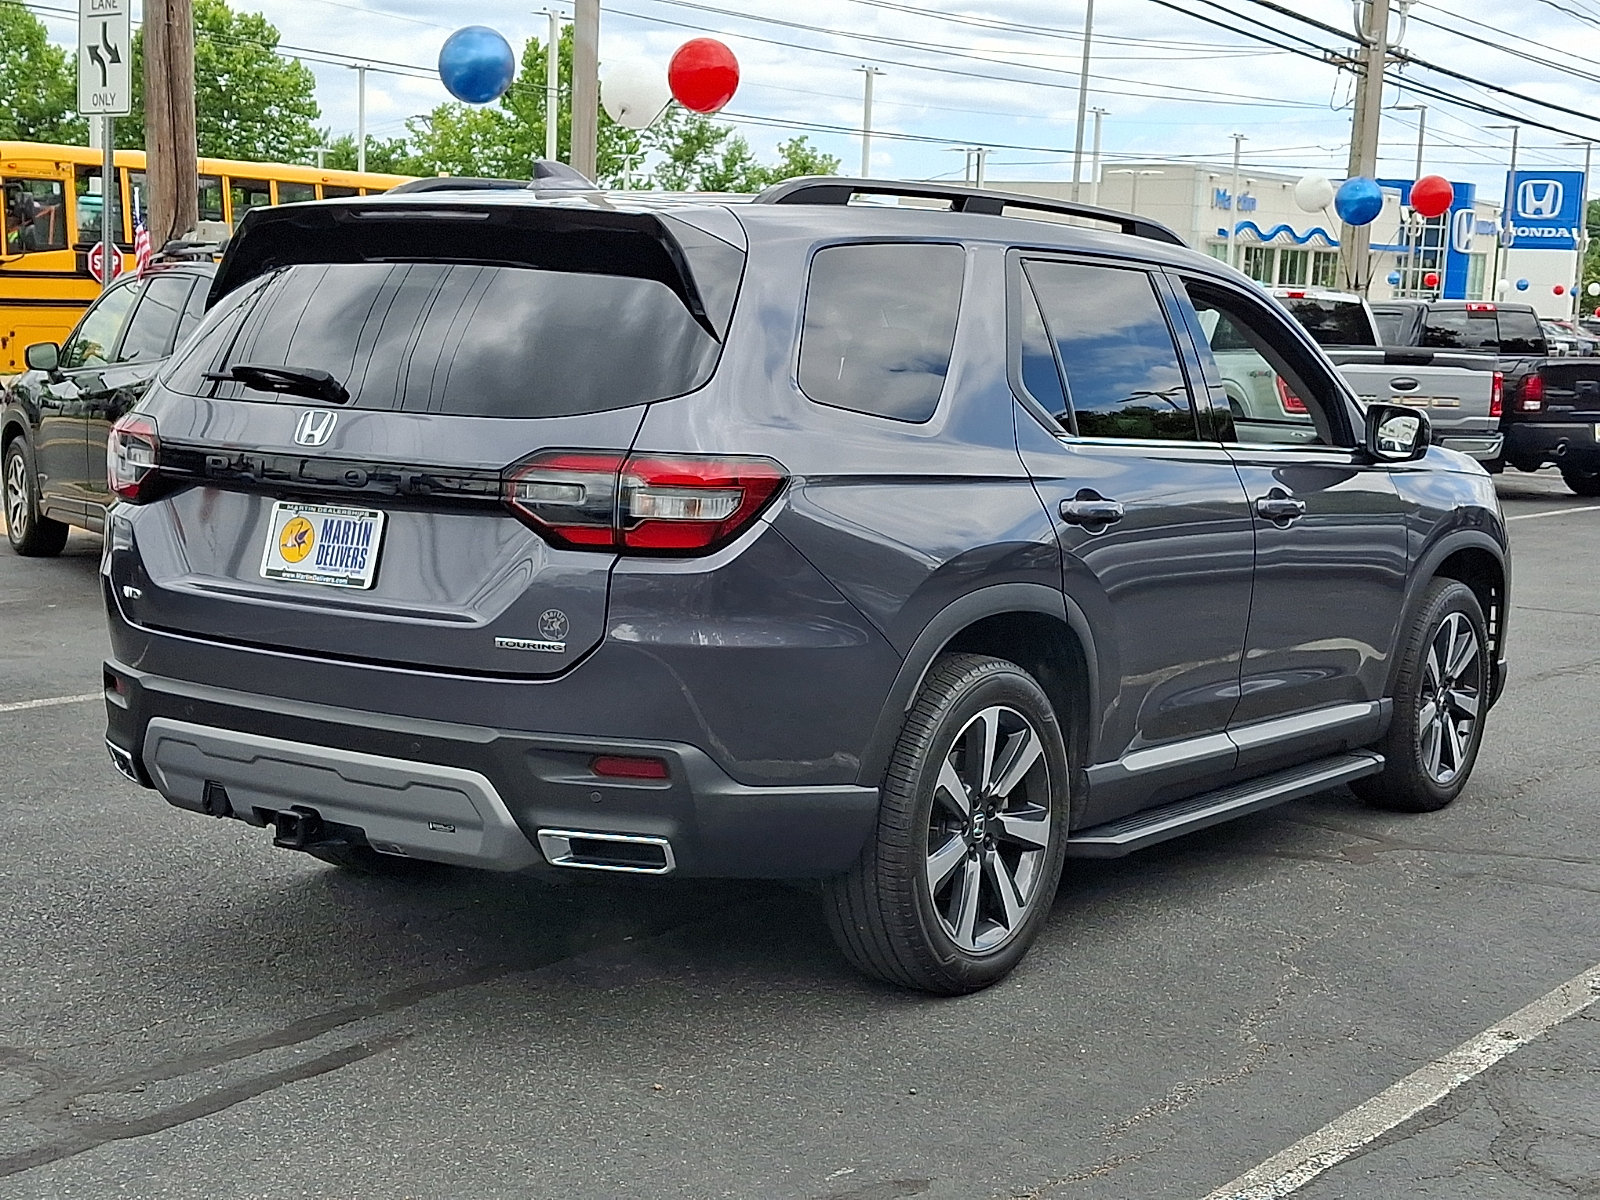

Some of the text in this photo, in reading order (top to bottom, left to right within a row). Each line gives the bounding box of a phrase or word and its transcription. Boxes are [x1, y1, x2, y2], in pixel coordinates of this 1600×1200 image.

[91, 0, 118, 10] LANE
[92, 93, 117, 107] ONLY
[93, 255, 119, 271] SP
[286, 504, 316, 513] MARTIN
[319, 518, 373, 548] MARTIN
[315, 543, 368, 570] DELIVERS
[497, 640, 563, 652] TOURING
